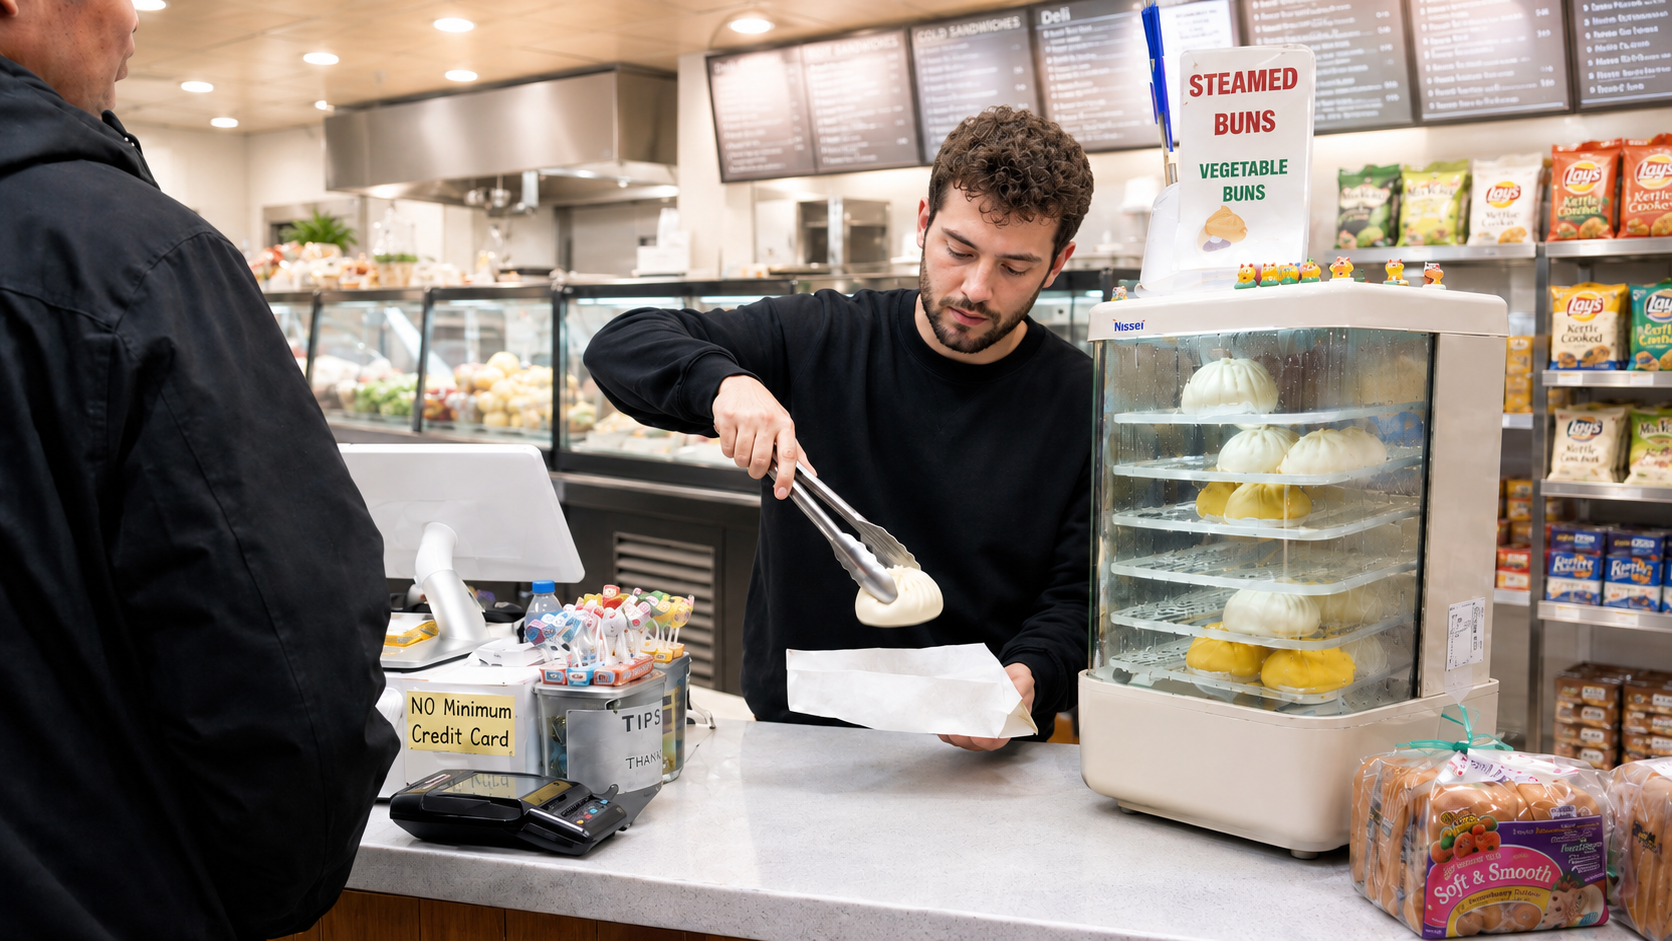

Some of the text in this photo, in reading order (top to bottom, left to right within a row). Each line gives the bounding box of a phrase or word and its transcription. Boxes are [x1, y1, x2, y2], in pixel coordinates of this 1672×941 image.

[1041, 7, 1070, 25] Deli
[1189, 67, 1298, 97] STEAMED
[1214, 110, 1276, 135] BUNS
[1199, 159, 1288, 179] VEGETABLE
[1222, 184, 1266, 202] BUNS
[1113, 320, 1145, 332] Nissei
[1561, 333, 1603, 344] Cooked
[411, 697, 512, 719] NO Minimum
[621, 708, 661, 732] TIPS
[411, 724, 510, 748] Credit Card
[1433, 870, 1470, 904] Soft
[1472, 870, 1486, 885] &
[1488, 862, 1552, 883] Smooth
